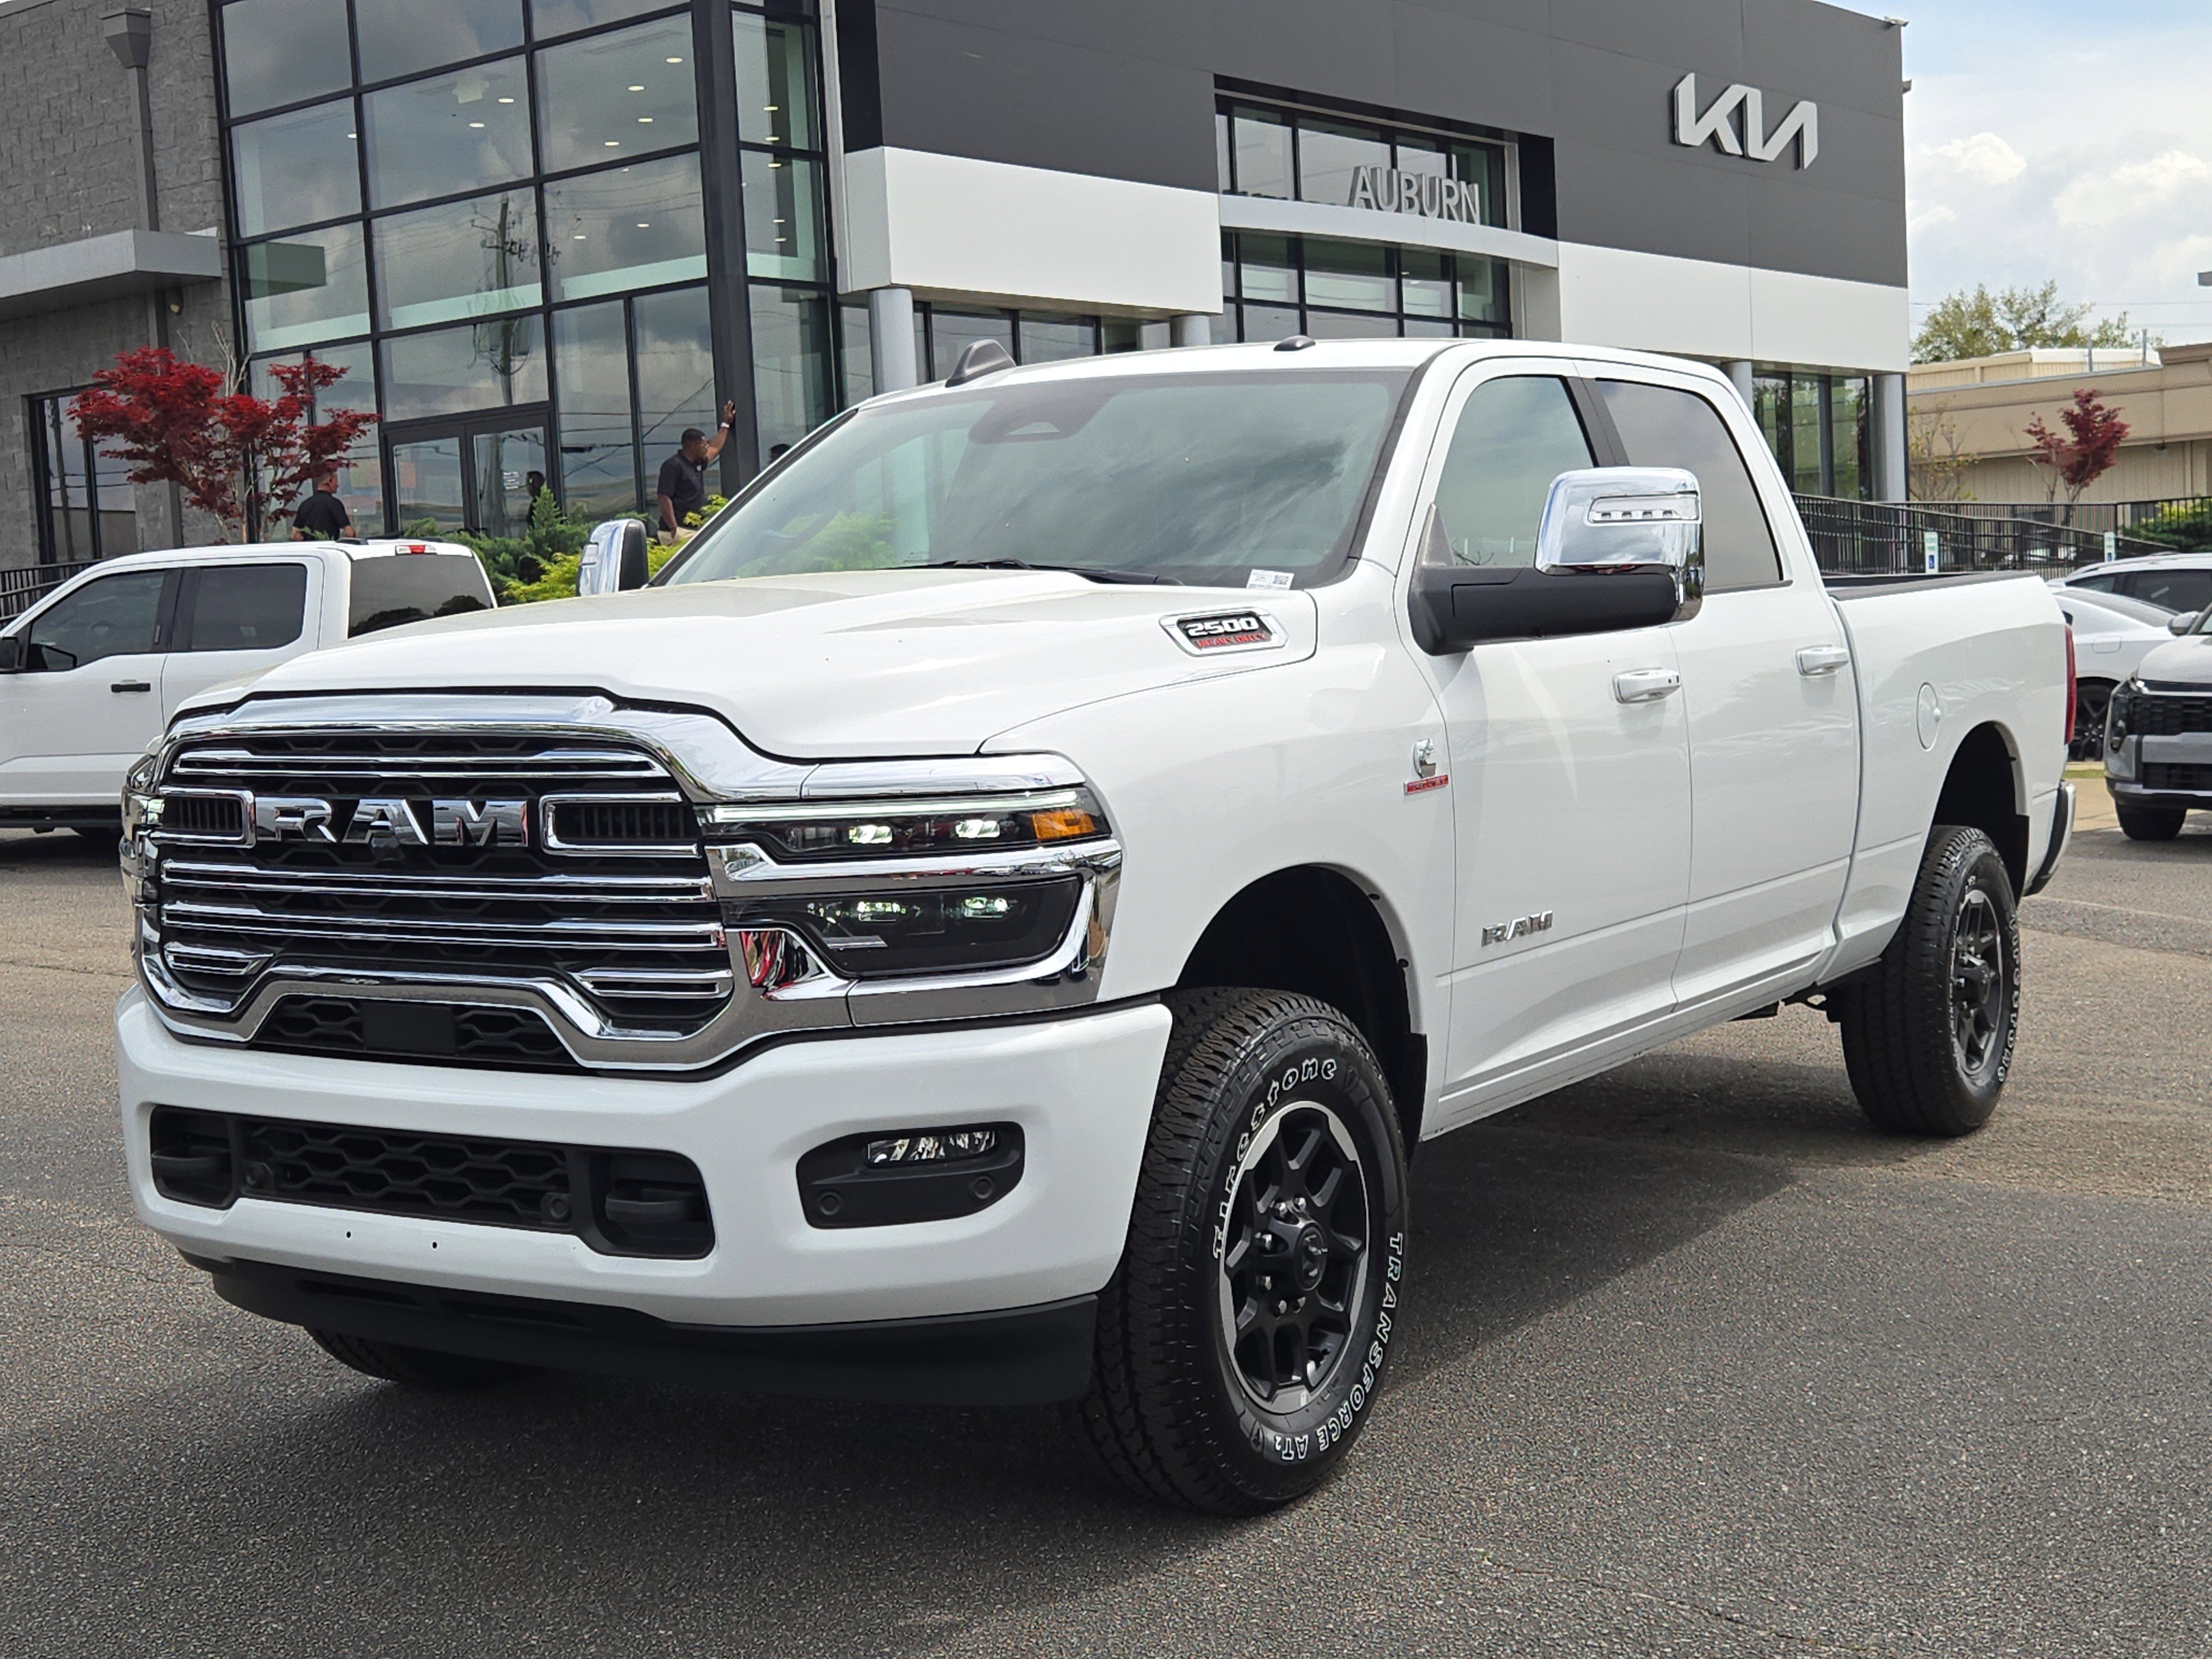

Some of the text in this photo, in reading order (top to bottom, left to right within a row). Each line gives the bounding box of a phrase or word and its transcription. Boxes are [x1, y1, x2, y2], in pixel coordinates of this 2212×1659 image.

[1674, 72, 1818, 170] KIA
[1349, 165, 1481, 225] AUBURN
[1185, 617, 1259, 636] 2500
[1195, 633, 1266, 647] HEAVY DUTY
[255, 796, 529, 846] RAM
[1482, 910, 1553, 947] RAM
[1316, 1232, 1403, 1452] TRANSFORCE
